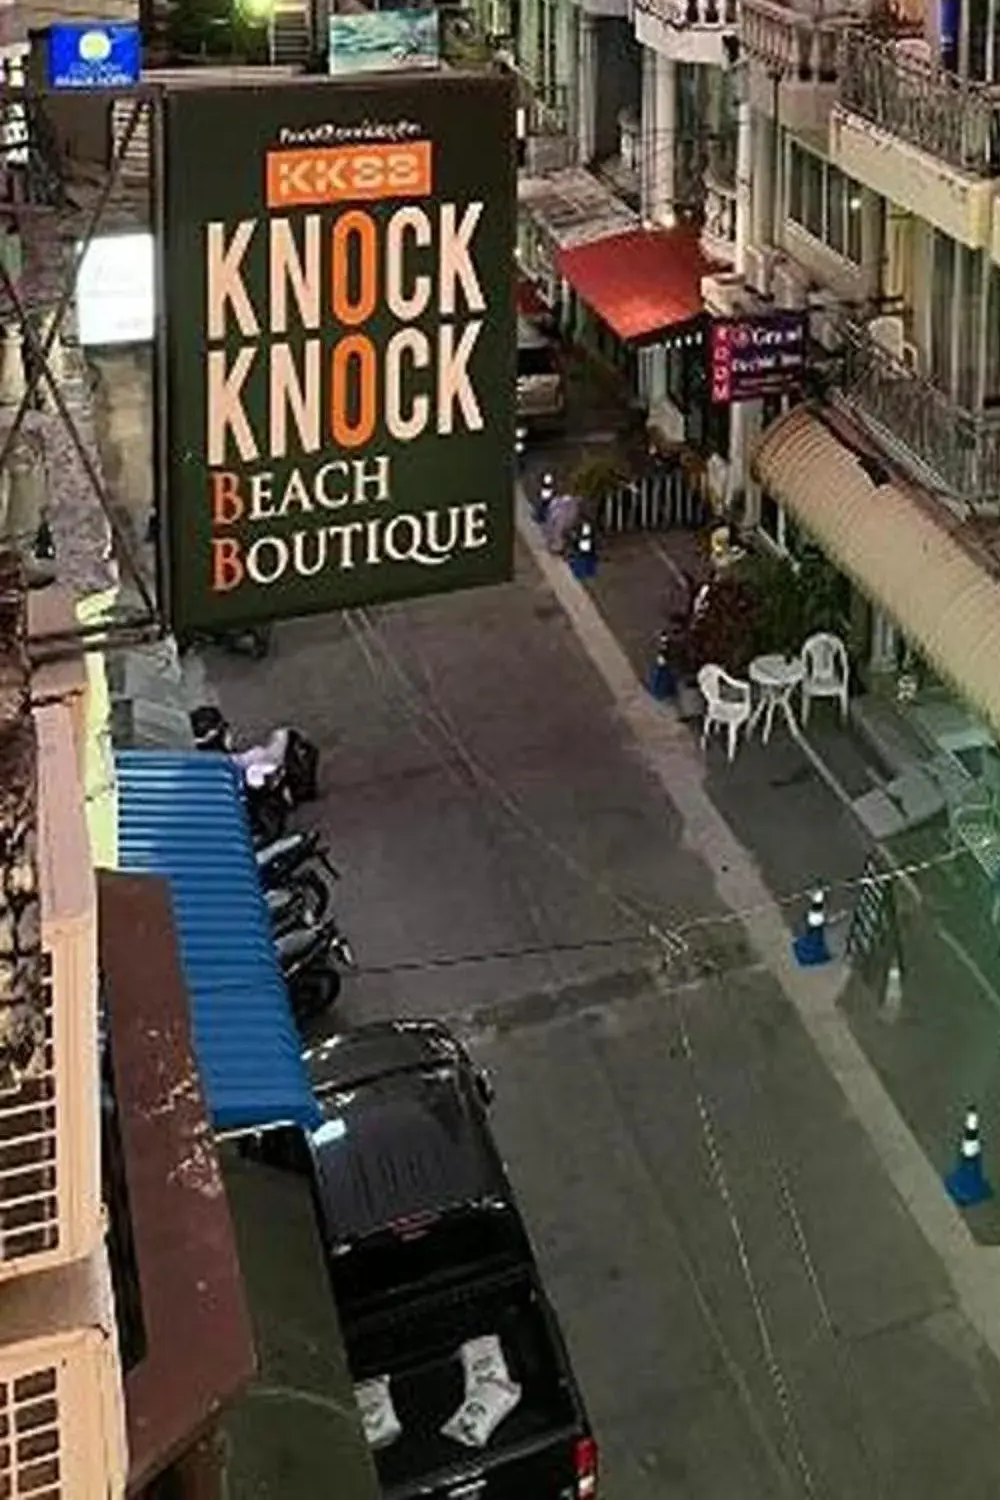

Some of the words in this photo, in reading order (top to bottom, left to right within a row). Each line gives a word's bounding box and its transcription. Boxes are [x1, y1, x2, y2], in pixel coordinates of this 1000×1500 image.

[207, 202, 486, 341] KNOCK
[207, 320, 485, 466] KNOCK
[211, 456, 391, 526] BEACH
[211, 503, 488, 592] BOUTIQUE
